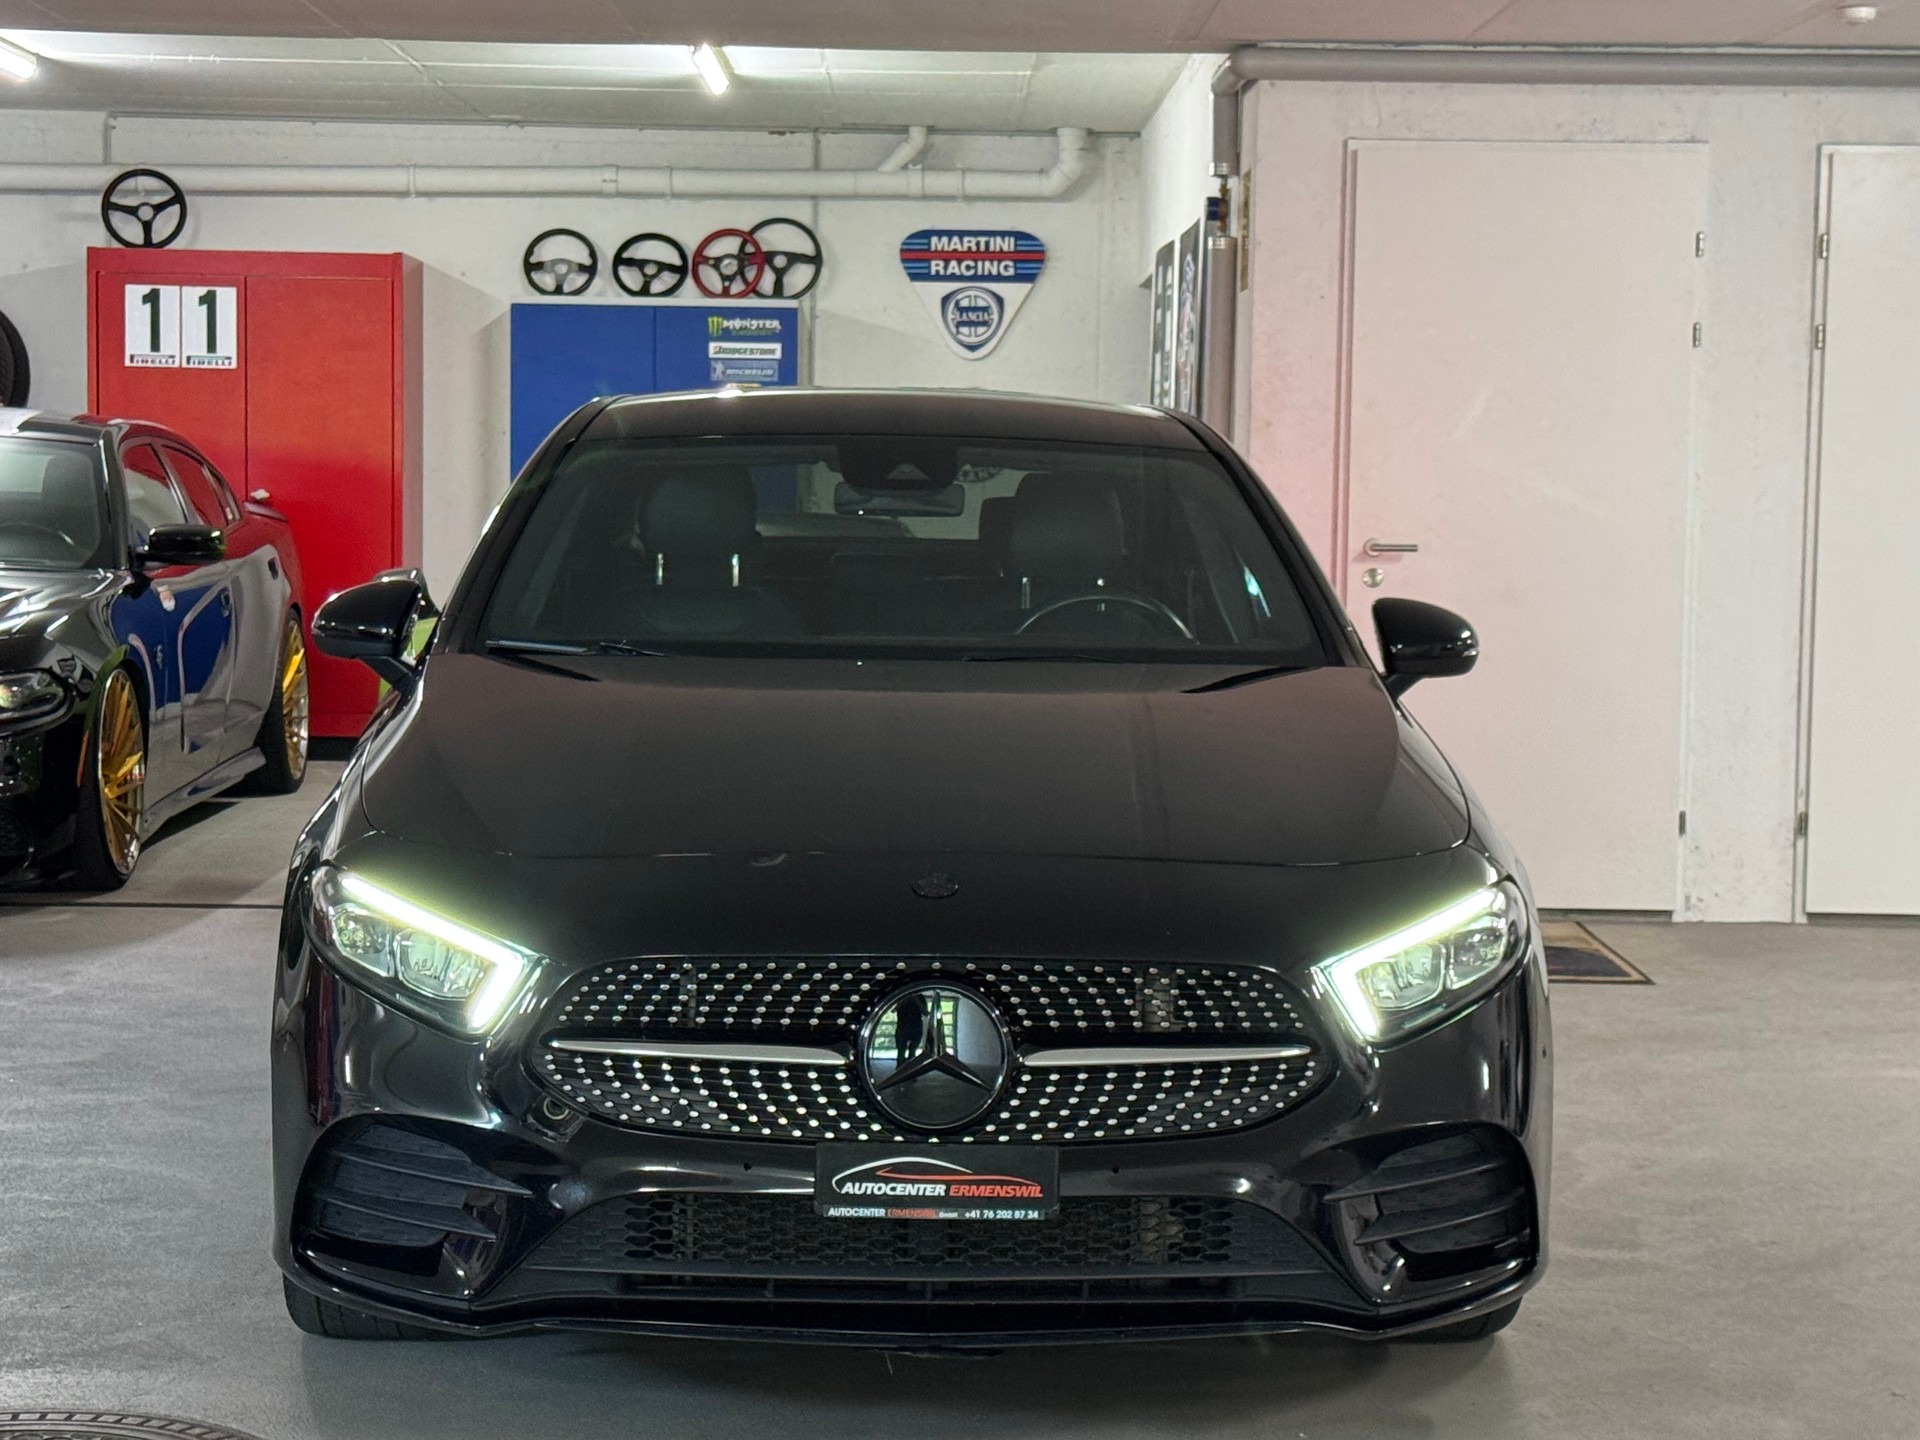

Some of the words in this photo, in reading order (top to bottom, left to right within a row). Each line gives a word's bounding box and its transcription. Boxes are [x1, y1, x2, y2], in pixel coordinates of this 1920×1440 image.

[930, 235, 1015, 252] MARTINI
[930, 260, 1015, 276] RACING
[722, 317, 782, 331] MONSTER
[956, 311, 989, 322] LANCIA
[841, 1182, 946, 1197] AUTOCENTER
[949, 1184, 1044, 1198] ERMENSWIL
[828, 1207, 886, 1217] AUTOCENTER
[887, 1208, 936, 1218] ERMENSWIL
[964, 1209, 980, 1219] +41
[982, 1209, 995, 1219] 76
[996, 1210, 1013, 1219] 202
[1027, 1210, 1039, 1219] 34
